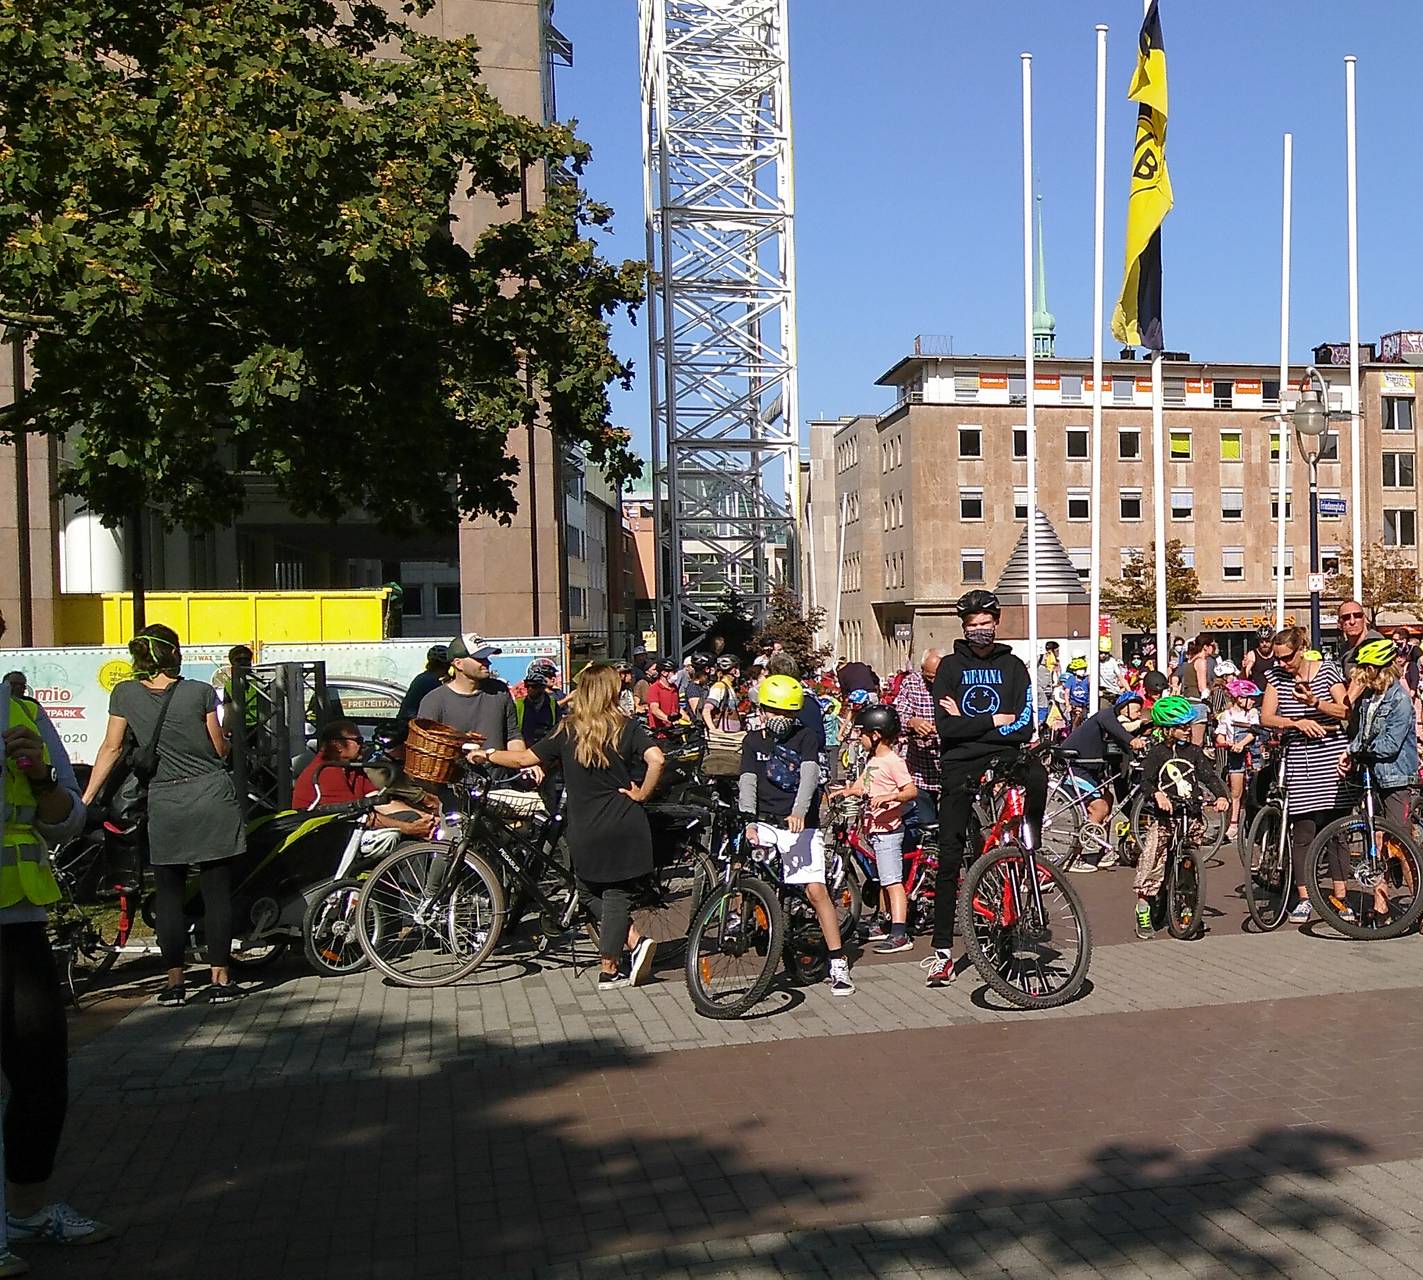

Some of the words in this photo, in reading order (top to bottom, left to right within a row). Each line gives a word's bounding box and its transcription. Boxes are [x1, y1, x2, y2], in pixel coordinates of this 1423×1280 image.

[1201, 616, 1233, 629] WOK
[1239, 616, 1248, 629] &
[1252, 615, 1296, 629] BOWS
[961, 669, 1003, 685] NIRVANA
[59, 733, 88, 743] 020
[498, 847, 520, 872] PEGASUS
